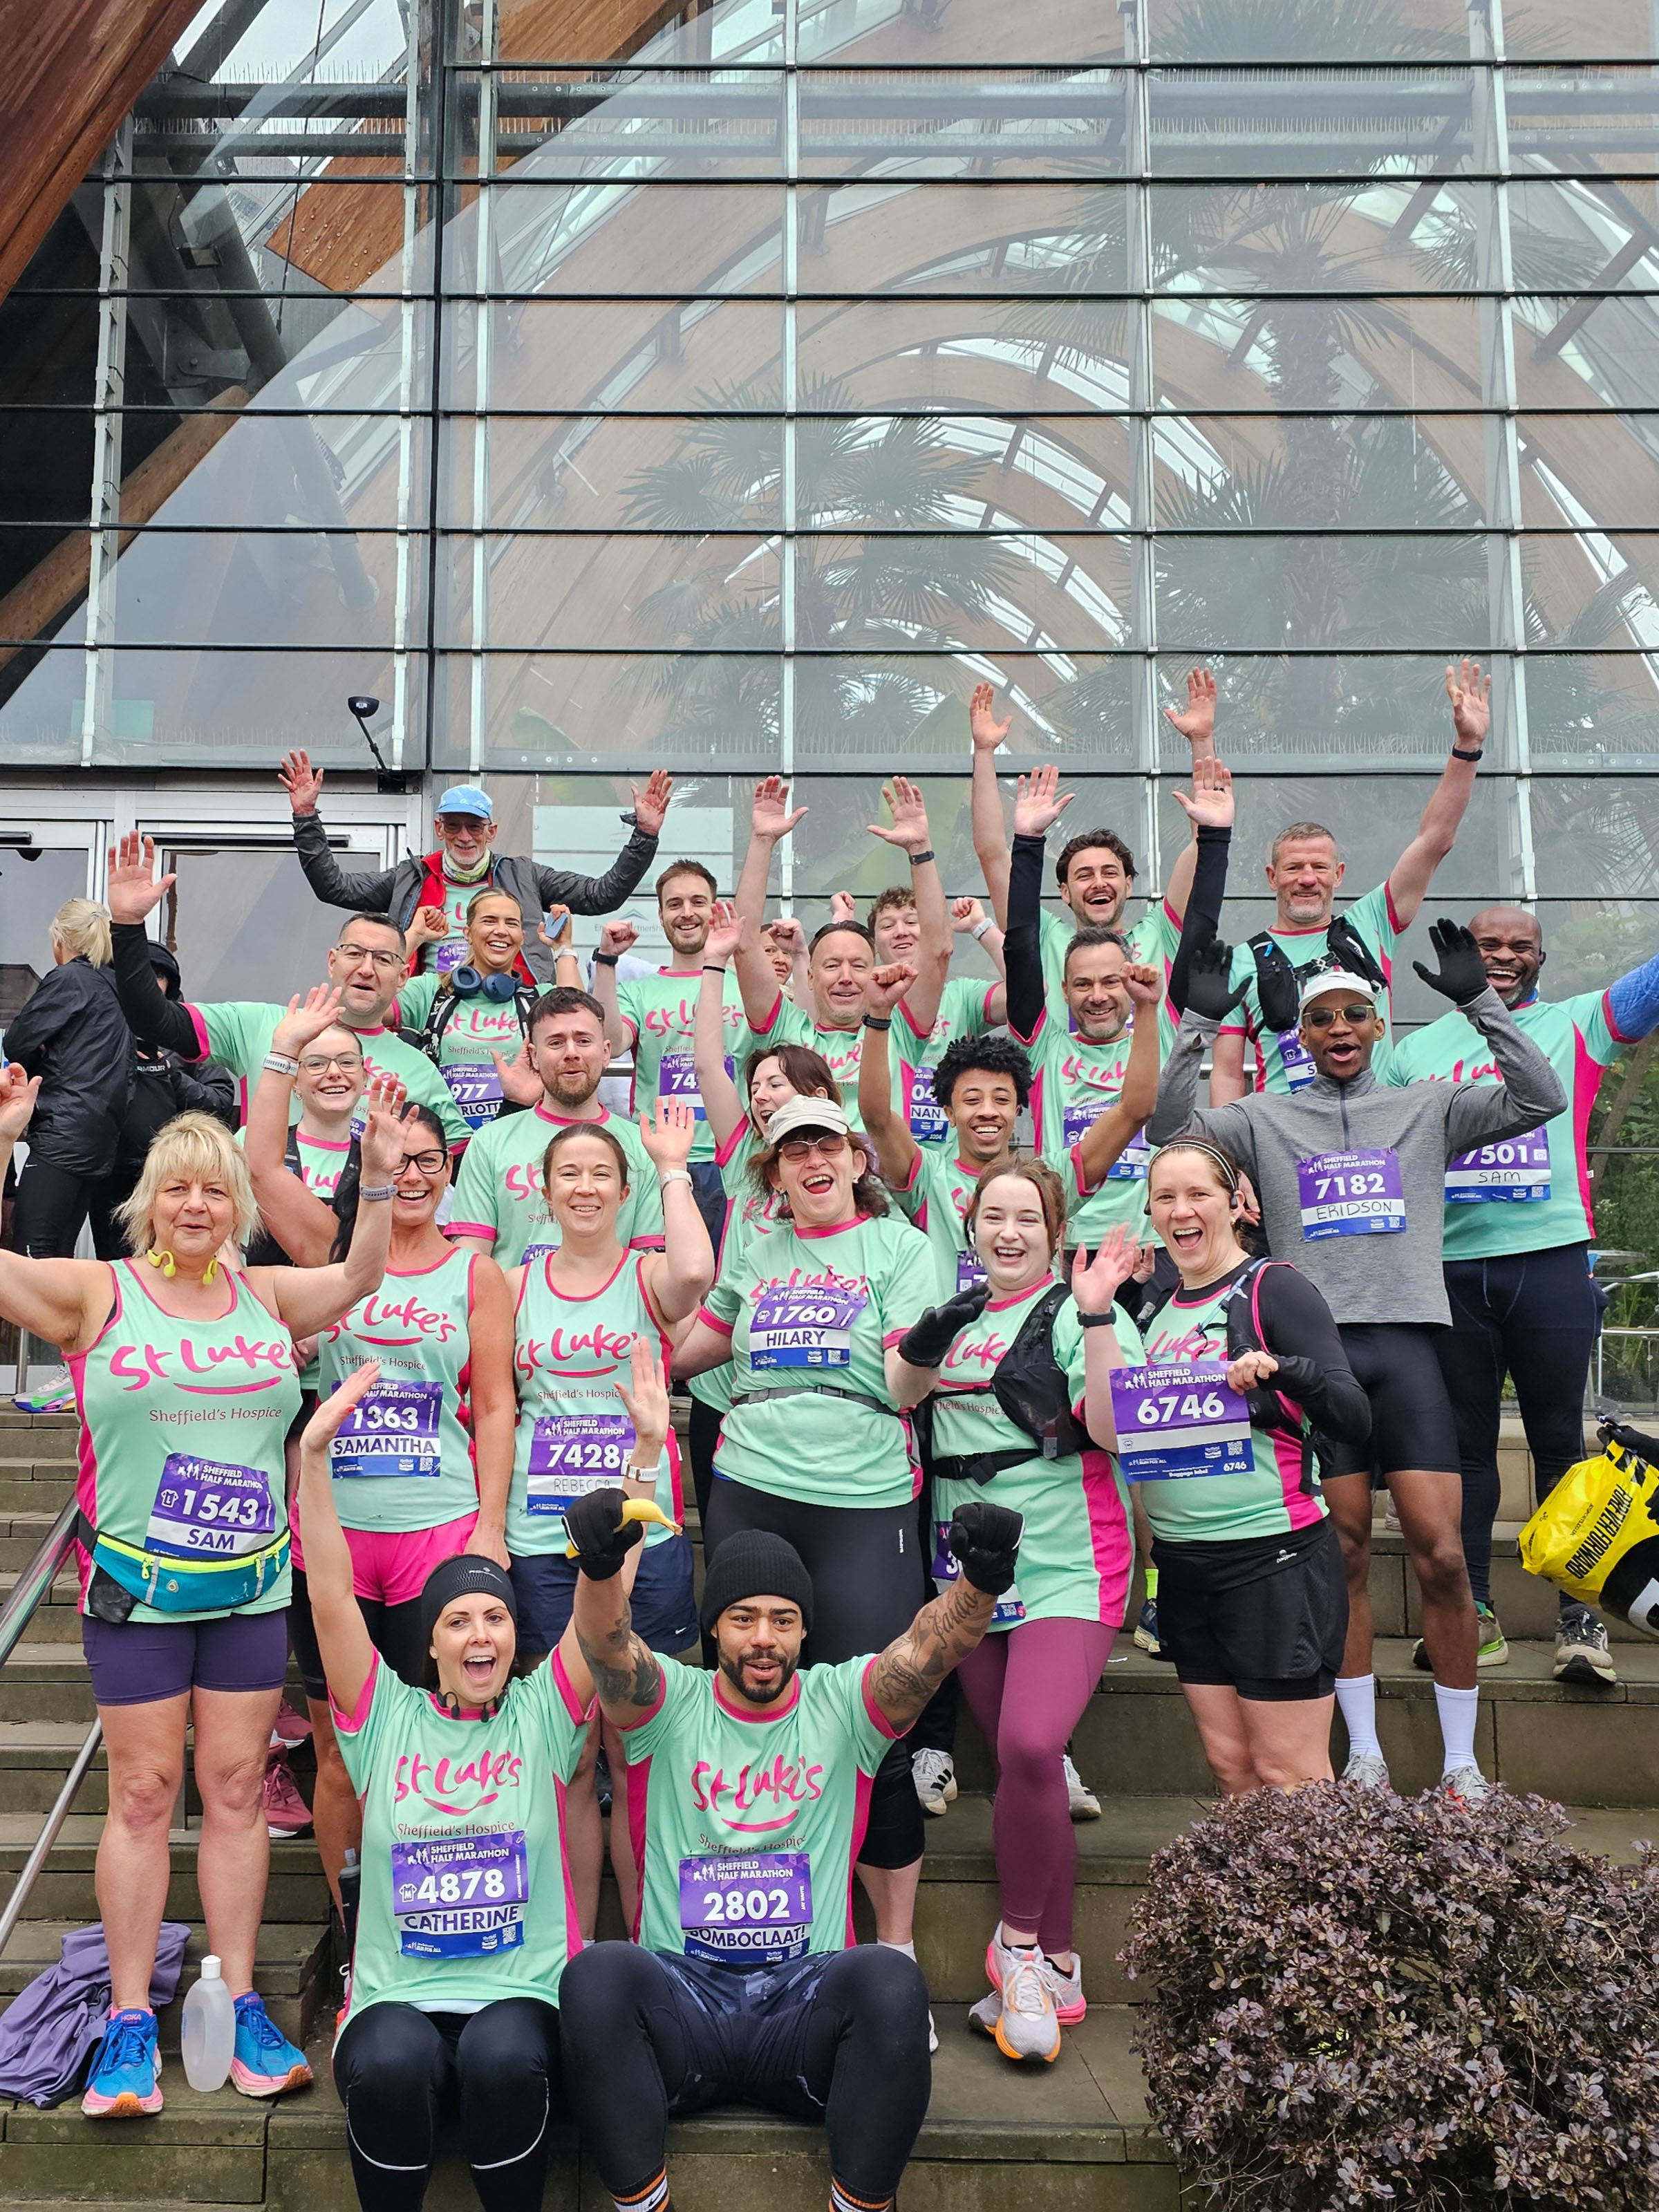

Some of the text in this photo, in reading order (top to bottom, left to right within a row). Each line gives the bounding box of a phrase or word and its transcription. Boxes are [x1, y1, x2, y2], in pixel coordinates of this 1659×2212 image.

[645, 1008, 675, 1037] St
[448, 1046, 485, 1055] Sheffield's
[1323, 1155, 1358, 1163] SHEFFIELD
[1324, 1160, 1386, 1171] HALF MARATHON
[1478, 1172, 1521, 1183] SAM
[1315, 1173, 1386, 1200] 7182
[1317, 1201, 1391, 1220] ERIDSON
[805, 1295, 850, 1305] MARATHON
[364, 1295, 457, 1342] Luke's
[771, 1306, 836, 1324] 1760
[767, 1331, 826, 1347] HILARY
[110, 1344, 173, 1391] St
[389, 1358, 427, 1370] Hospice
[516, 1338, 545, 1380] St
[1147, 1368, 1191, 1379] SHEFFIELD
[1149, 1374, 1226, 1387] HALF MARATHON
[380, 1389, 427, 1399] MARATHON
[538, 1389, 619, 1401] Sheffield's Hospic
[149, 1406, 282, 1425] Sheffield's Hospice
[1137, 1392, 1224, 1425] 6746
[353, 1405, 418, 1430] 1363
[563, 1419, 597, 1427] SHEFFIELD
[563, 1427, 626, 1436] HALF MARATHON
[333, 1438, 436, 1455] SAMANTHA
[547, 1444, 621, 1469] 7428
[203, 1465, 242, 1478] SHEFFIELD
[1224, 1461, 1247, 1472] 6746
[200, 1472, 222, 1485] HALF
[182, 1489, 259, 1526] 1543
[1596, 1484, 1633, 1537] FOREVER
[187, 1528, 235, 1550] SAM
[1565, 1521, 1613, 1580] FORWARD
[394, 1750, 522, 1803] St Luke's
[691, 1754, 823, 1812] St Luke's
[397, 1821, 514, 1839] Sheffield's Hospice
[431, 1843, 475, 1853] SHEFFIELD
[698, 1833, 759, 1854] Sheffield's
[431, 1848, 509, 1864] HALF MARATHON
[717, 1861, 759, 1871] SHEFFIELD
[717, 1869, 793, 1880] HALF MARATHON
[418, 1869, 505, 1904] 4878
[704, 1889, 790, 1921] 2802
[404, 1906, 519, 1931] CATHERINE
[121, 2014, 142, 2022] HOKA
